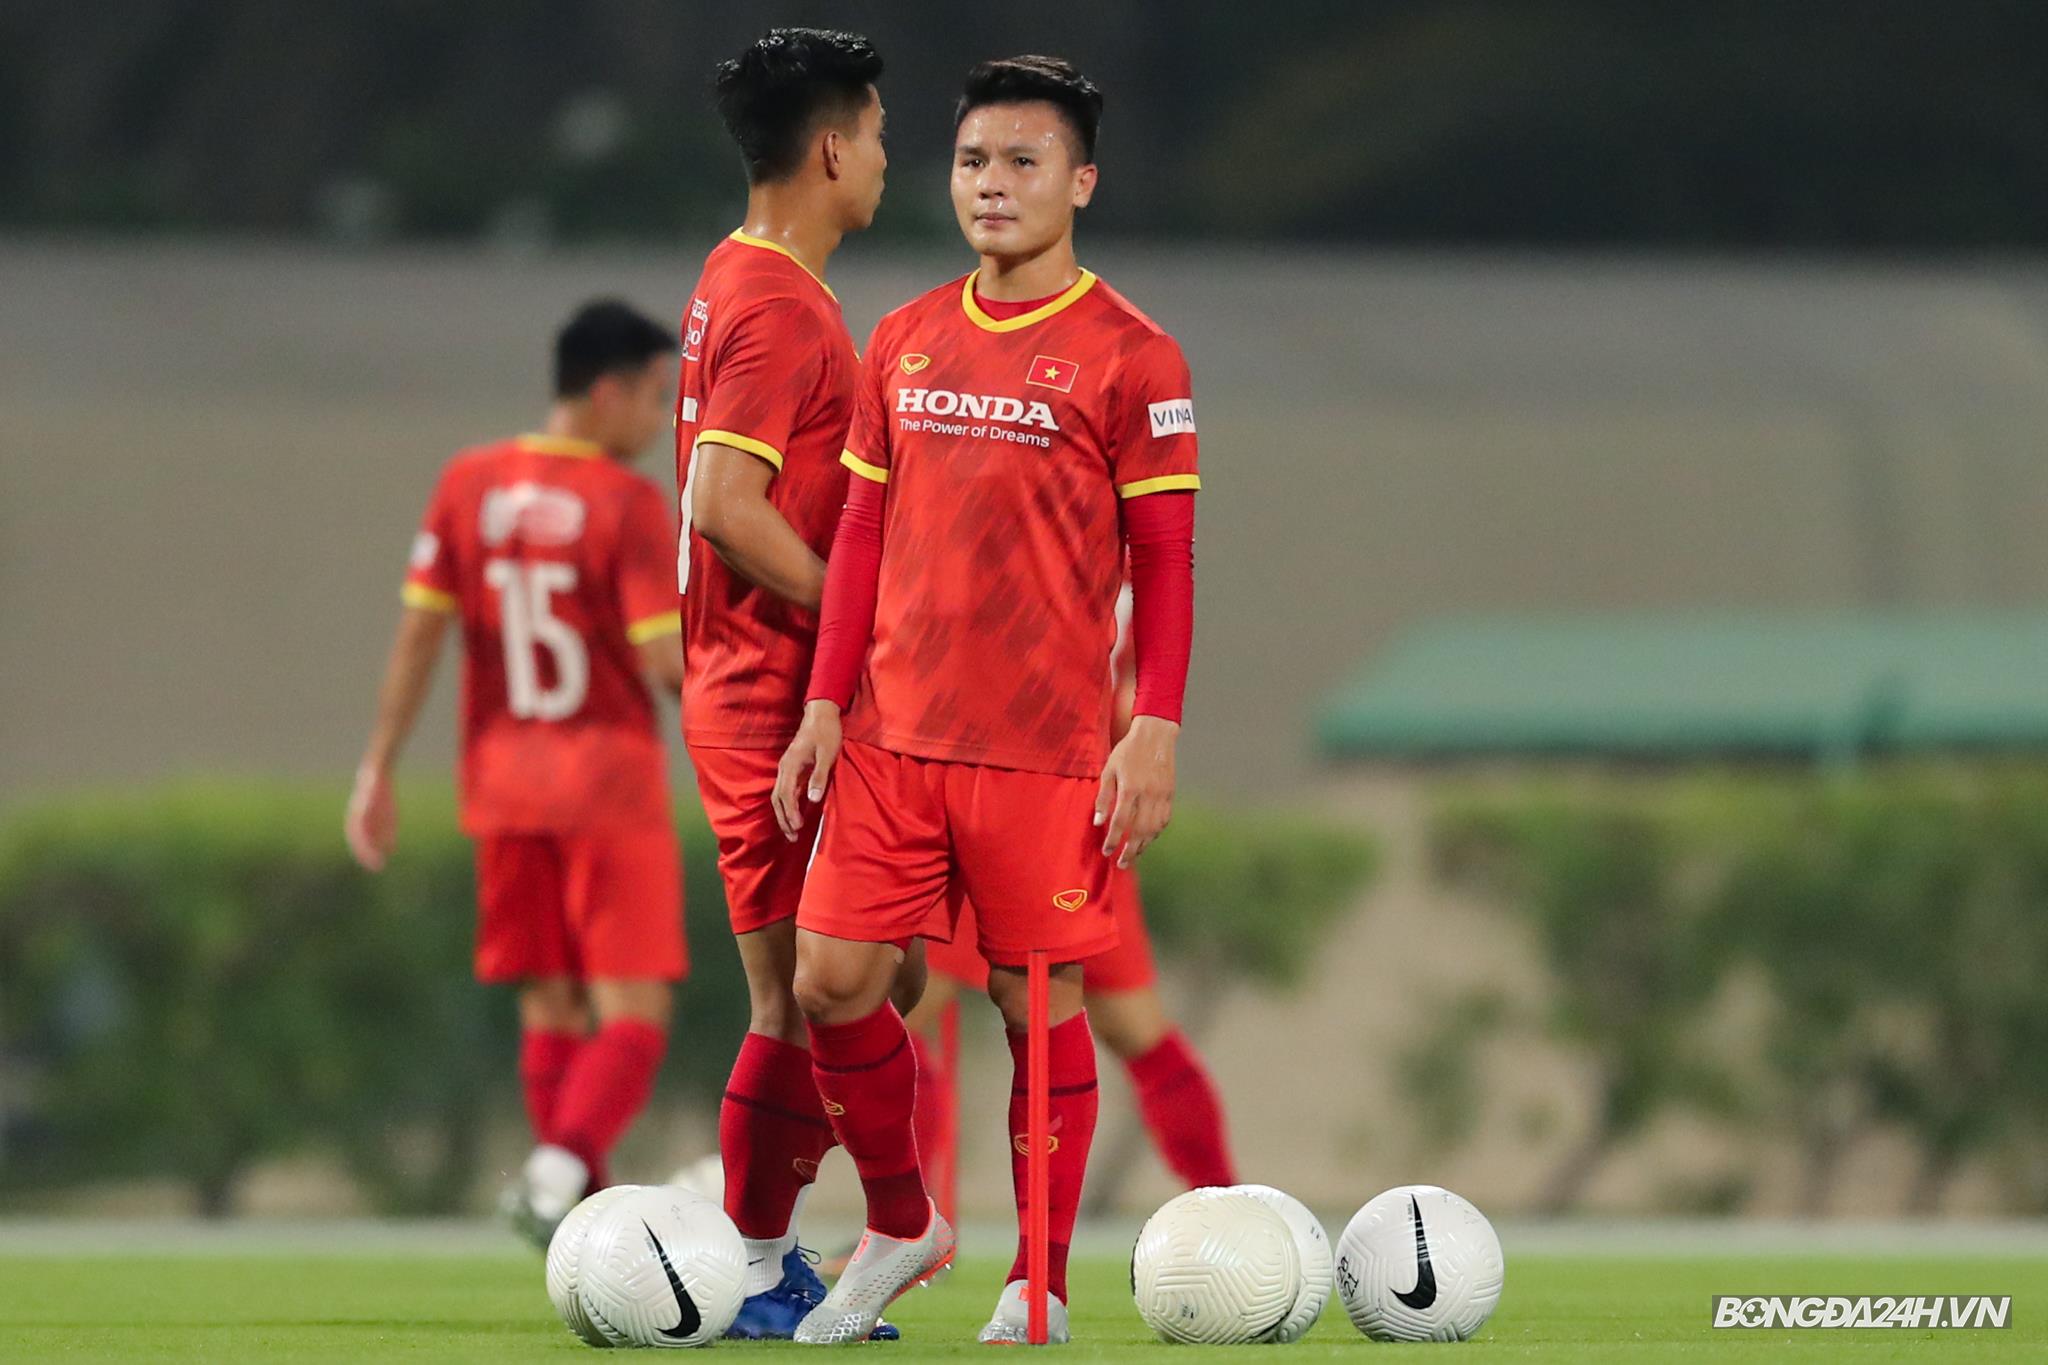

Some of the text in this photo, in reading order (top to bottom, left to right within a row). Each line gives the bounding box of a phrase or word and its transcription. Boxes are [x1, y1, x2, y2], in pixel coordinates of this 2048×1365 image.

[896, 388, 1059, 431] HONDA
[1153, 408, 1192, 427] VINA
[899, 418, 1050, 448] The Power of Dreams
[483, 558, 589, 722] 15
